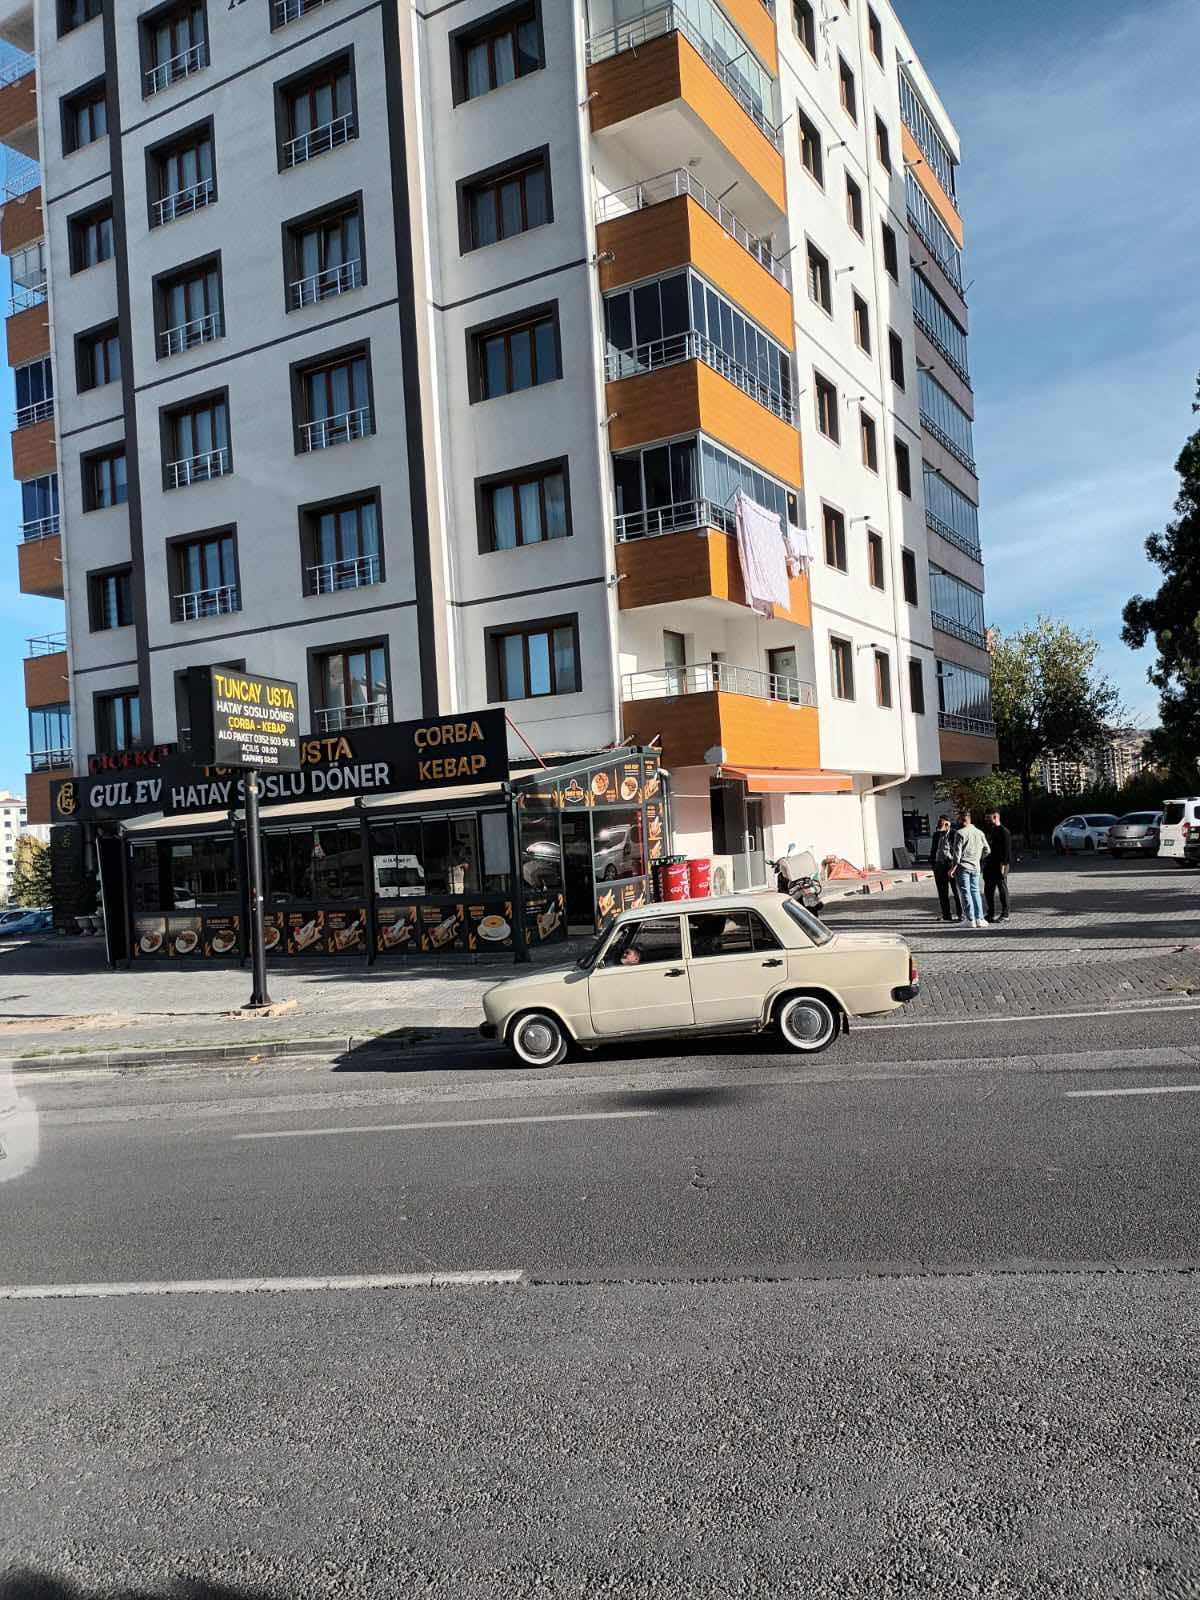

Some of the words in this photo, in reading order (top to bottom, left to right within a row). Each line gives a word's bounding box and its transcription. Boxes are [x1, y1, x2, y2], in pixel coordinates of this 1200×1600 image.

[214, 674, 262, 704] TUNCAY
[266, 685, 295, 709] USTA
[216, 699, 243, 715] HATAY
[243, 704, 269, 719] SOSLU
[269, 707, 295, 723] DÖNER
[218, 729, 233, 740] ALO
[233, 731, 254, 743] PAKET
[228, 716, 256, 732] ÇORBA
[262, 720, 287, 735] KEBAP
[414, 720, 485, 753] ÇORBA
[418, 754, 487, 781] KEBAP
[171, 781, 232, 809] HATAY
[311, 762, 390, 793] DÖNER
